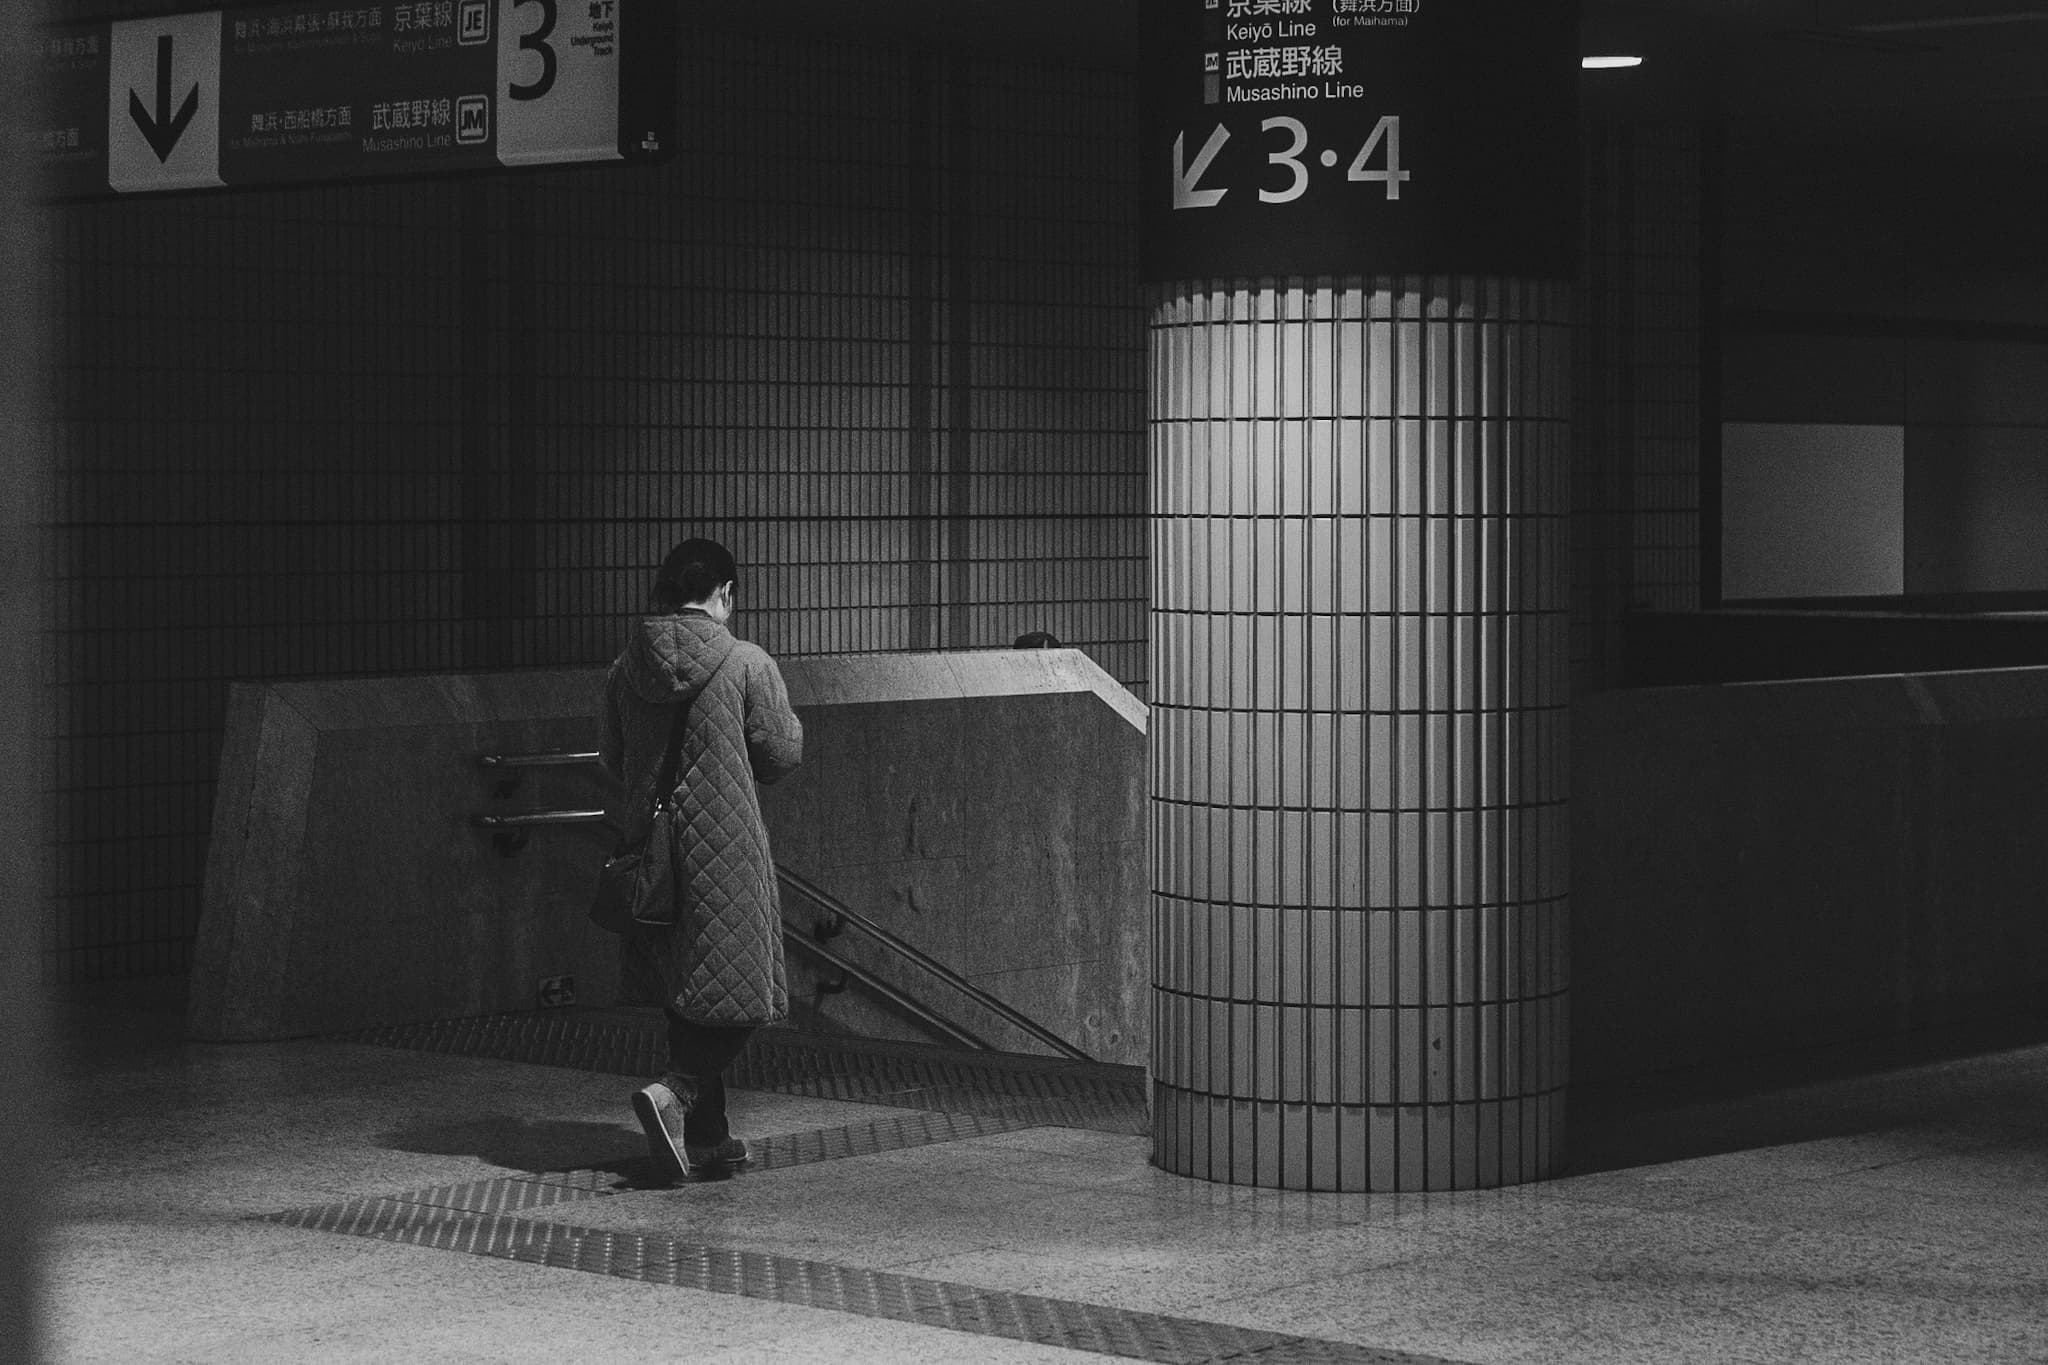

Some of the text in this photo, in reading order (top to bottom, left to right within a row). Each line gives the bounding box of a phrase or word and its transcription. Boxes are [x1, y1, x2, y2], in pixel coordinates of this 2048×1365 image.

[393, 1, 452, 32] 京葉線
[465, 10, 482, 32] JE
[1332, 15, 1409, 27] (for Maihama)
[1227, 20, 1316, 43] Keiyō Line
[508, 0, 558, 101] 3
[1226, 45, 1343, 79] 武蔵野線
[1227, 81, 1364, 103] Musashino Line
[371, 97, 451, 130] 武蔵野線
[461, 108, 483, 130] JM
[362, 134, 424, 153] Musashino
[426, 132, 451, 149] Line
